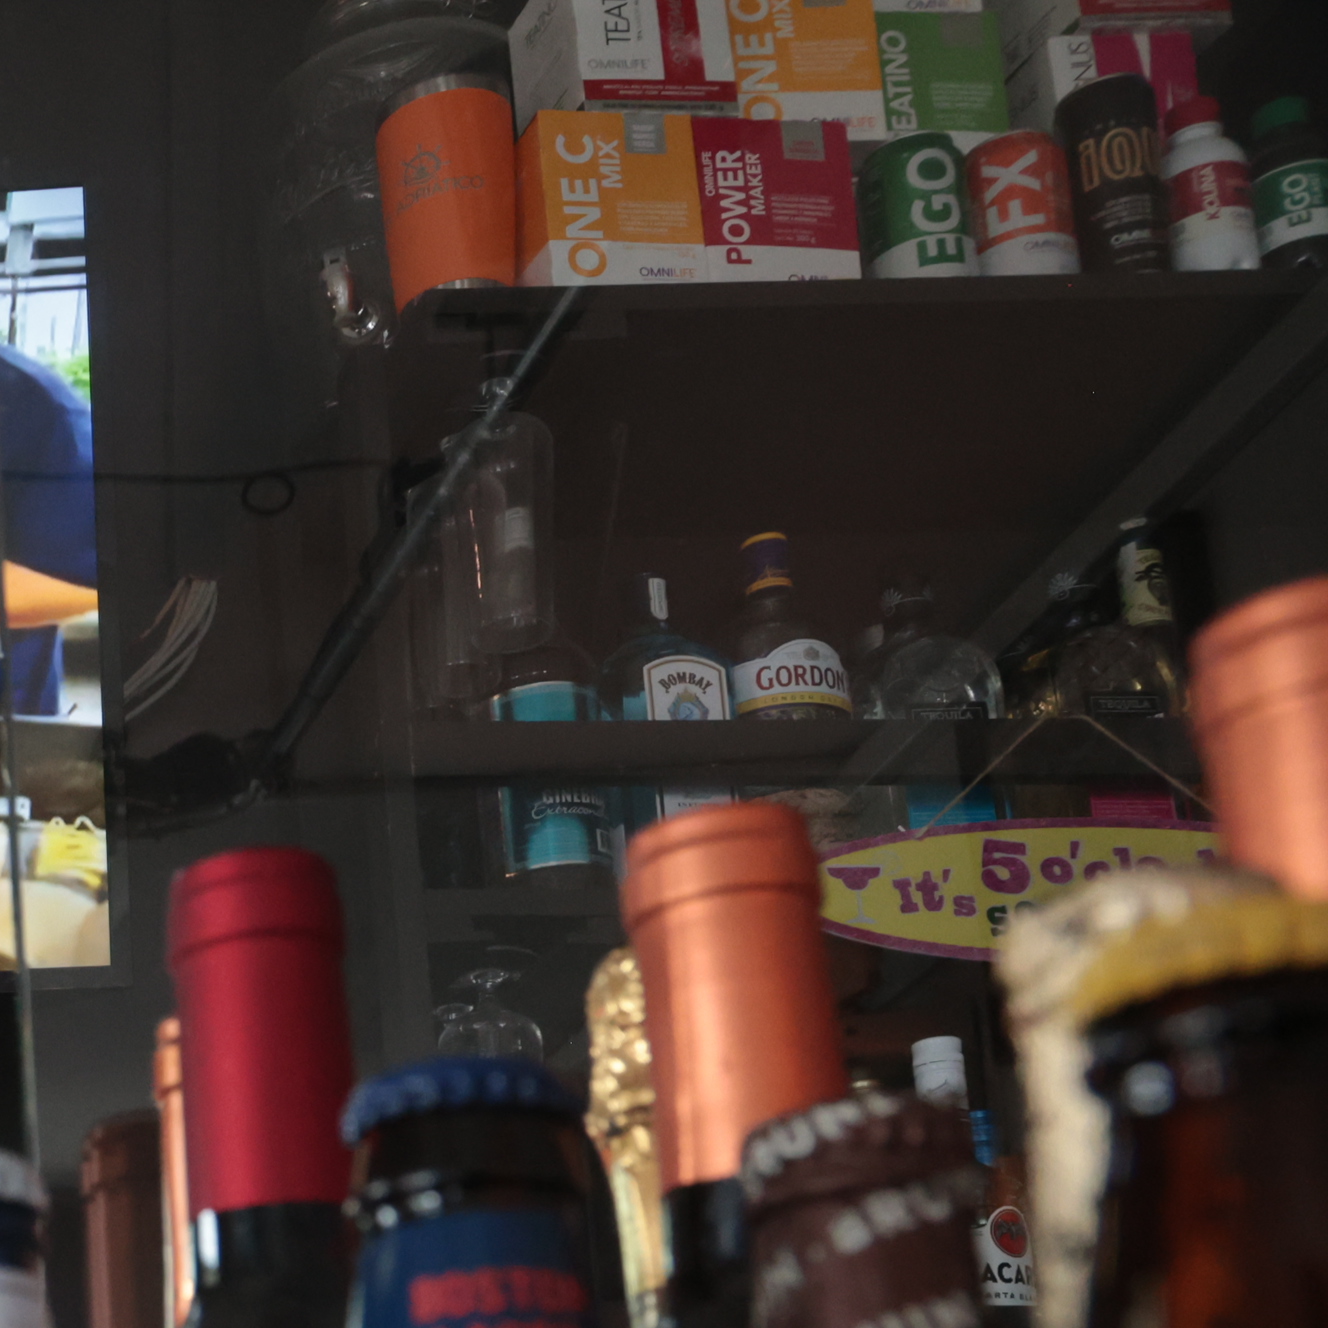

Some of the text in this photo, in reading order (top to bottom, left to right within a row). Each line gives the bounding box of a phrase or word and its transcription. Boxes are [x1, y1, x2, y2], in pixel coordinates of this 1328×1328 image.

[555, 133, 607, 278] ONE C
[597, 138, 624, 189] MIX
[745, 152, 766, 215] MAKER
[980, 148, 1046, 240] FX
[715, 150, 752, 265] POWER
[906, 147, 966, 268] EGO
[639, 266, 696, 278] OMNILIFE
[893, 868, 978, 919] It's
[981, 838, 1032, 895] 5
